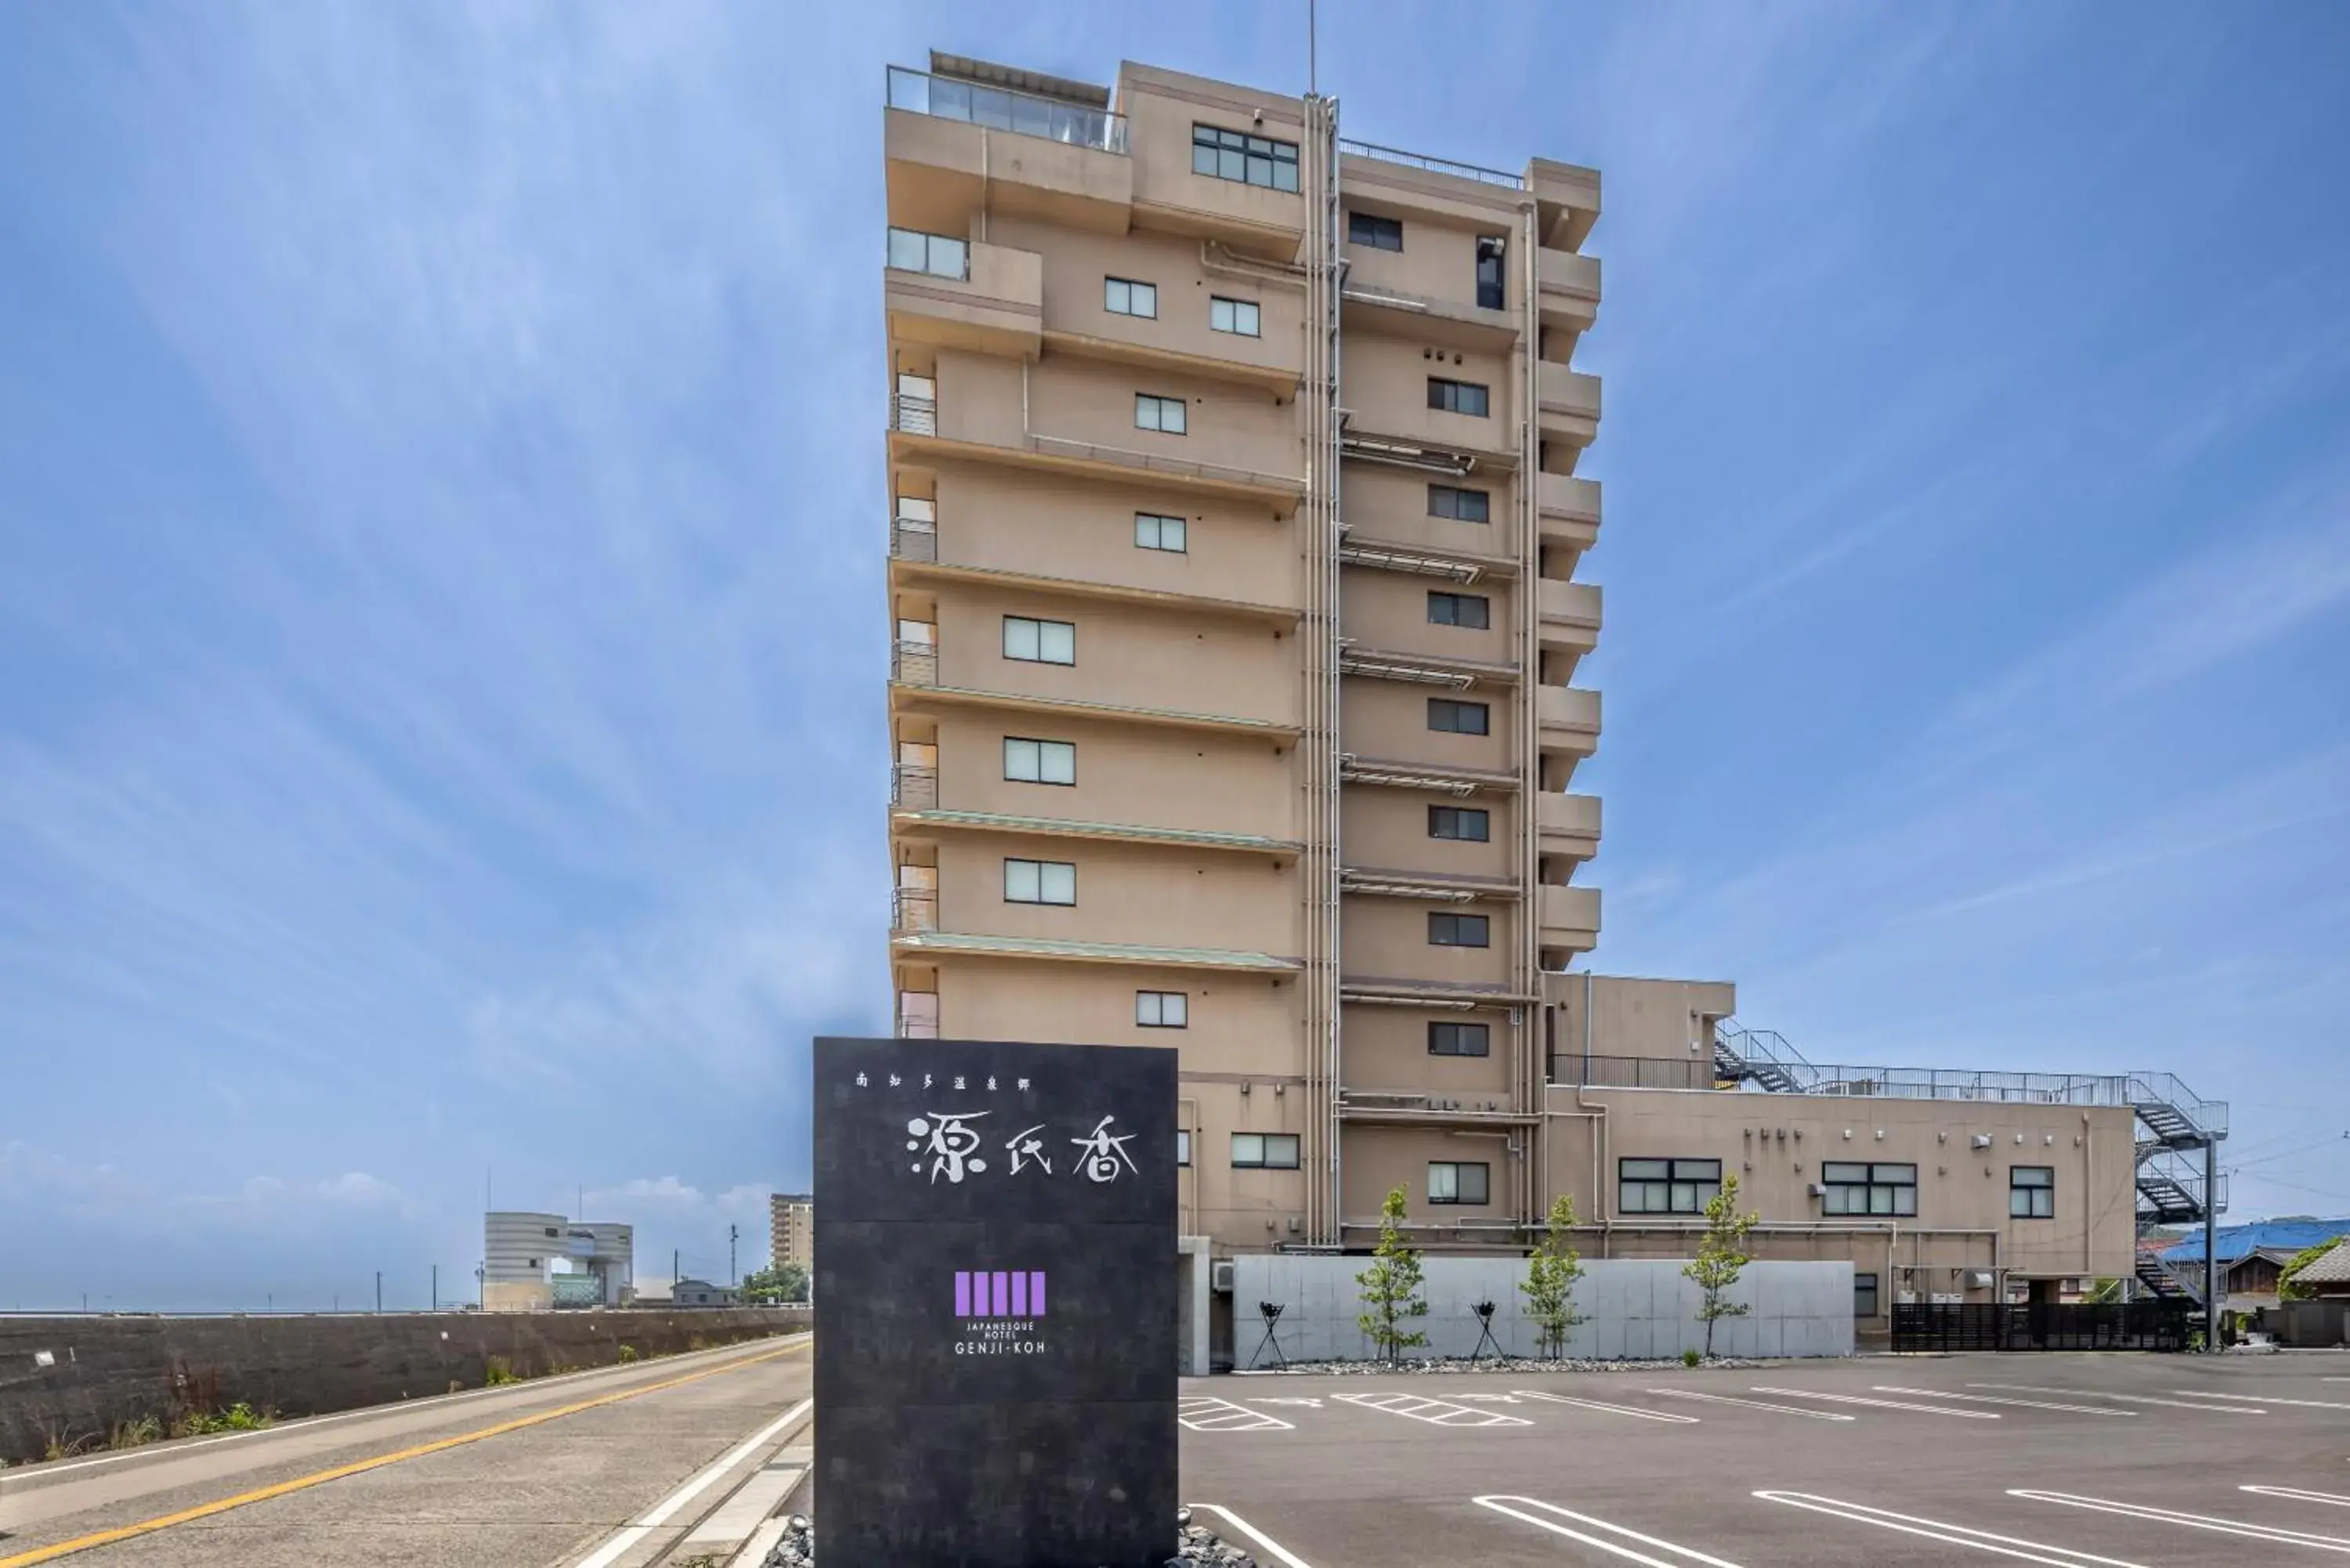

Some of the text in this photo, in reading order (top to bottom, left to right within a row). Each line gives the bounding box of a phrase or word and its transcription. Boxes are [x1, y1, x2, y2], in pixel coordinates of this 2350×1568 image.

[906, 1111, 1138, 1184] 源氏香
[967, 1321, 1034, 1331] JAPANESQUE
[985, 1331, 1016, 1339] HOTEL
[955, 1342, 1045, 1355] GENJI-KOH
